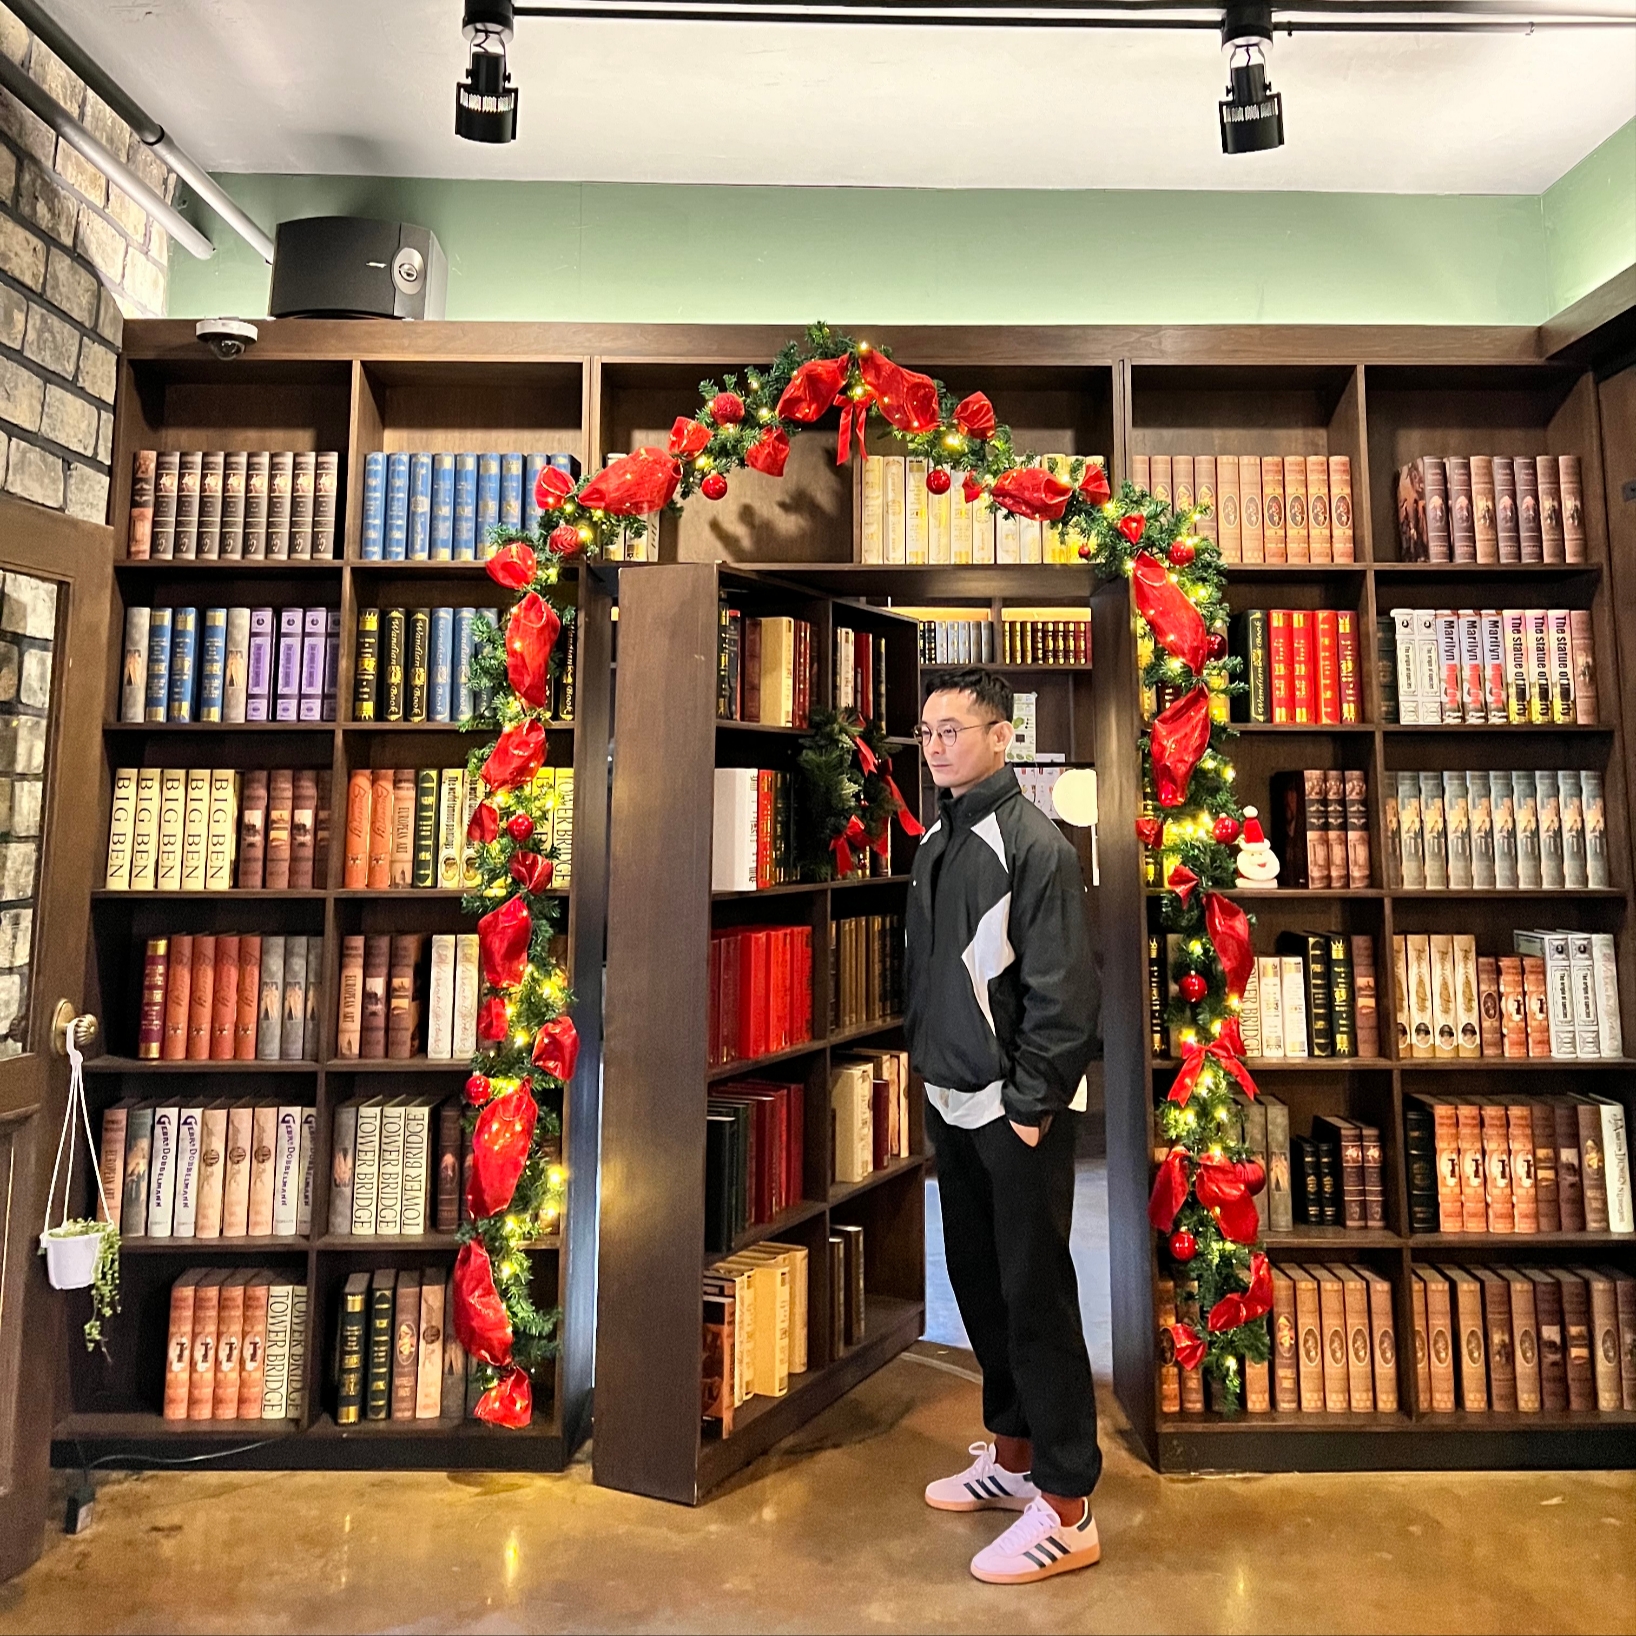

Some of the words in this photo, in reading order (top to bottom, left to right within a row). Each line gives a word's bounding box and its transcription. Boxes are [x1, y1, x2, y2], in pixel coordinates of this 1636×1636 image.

[1254, 621, 1263, 646] Book
[1442, 620, 1456, 661] Marilyn
[1464, 620, 1479, 660] Marilyn
[1487, 620, 1502, 660] Marilyn
[1512, 617, 1523, 635] The
[1534, 616, 1546, 634] The
[1556, 616, 1567, 634] The
[1513, 637, 1525, 669] statue
[1535, 637, 1547, 669] statue
[1557, 637, 1569, 669] statue
[435, 686, 443, 712] Book
[1515, 671, 1525, 682] of
[1538, 671, 1548, 682] of
[1558, 671, 1569, 682] of
[390, 686, 398, 713] Book
[412, 687, 420, 714] Book
[564, 686, 573, 714] Book
[114, 777, 131, 822] BIG
[138, 777, 154, 823] BIG
[163, 777, 180, 823] BIG
[188, 778, 204, 823] BIG
[212, 778, 229, 824] BIG
[447, 787, 458, 802] world
[448, 776, 458, 786] The
[557, 775, 574, 824] TOWER
[397, 807, 409, 840] EUROPEAN
[446, 803, 458, 823] famous
[109, 833, 126, 878] BEN
[134, 833, 150, 879] BEN
[161, 833, 177, 879] BEN
[185, 833, 201, 880] BEN
[209, 834, 225, 880] BEN
[396, 842, 408, 853] ART
[444, 824, 455, 849] paintings
[554, 830, 571, 882] BRIDGE
[344, 975, 357, 1009] EUROPEAN
[343, 1011, 354, 1023] ART
[1239, 1008, 1260, 1055] BRIDGE
[358, 1113, 377, 1167] TOWER
[382, 1113, 401, 1167] TOWER
[405, 1113, 425, 1169] BRIDGE
[156, 1148, 170, 1207] DOBBELMANN
[183, 1149, 197, 1208] DOBBELMANN
[281, 1147, 295, 1206] DOBBELMANN
[354, 1173, 374, 1228] BRIDGE
[379, 1172, 399, 1228] BRIDGE
[402, 1174, 422, 1229] TOWER
[267, 1292, 289, 1349] TOWER
[292, 1293, 307, 1349] TOWER
[263, 1354, 286, 1412] BRIDGE
[288, 1353, 304, 1411] BRIDGE
